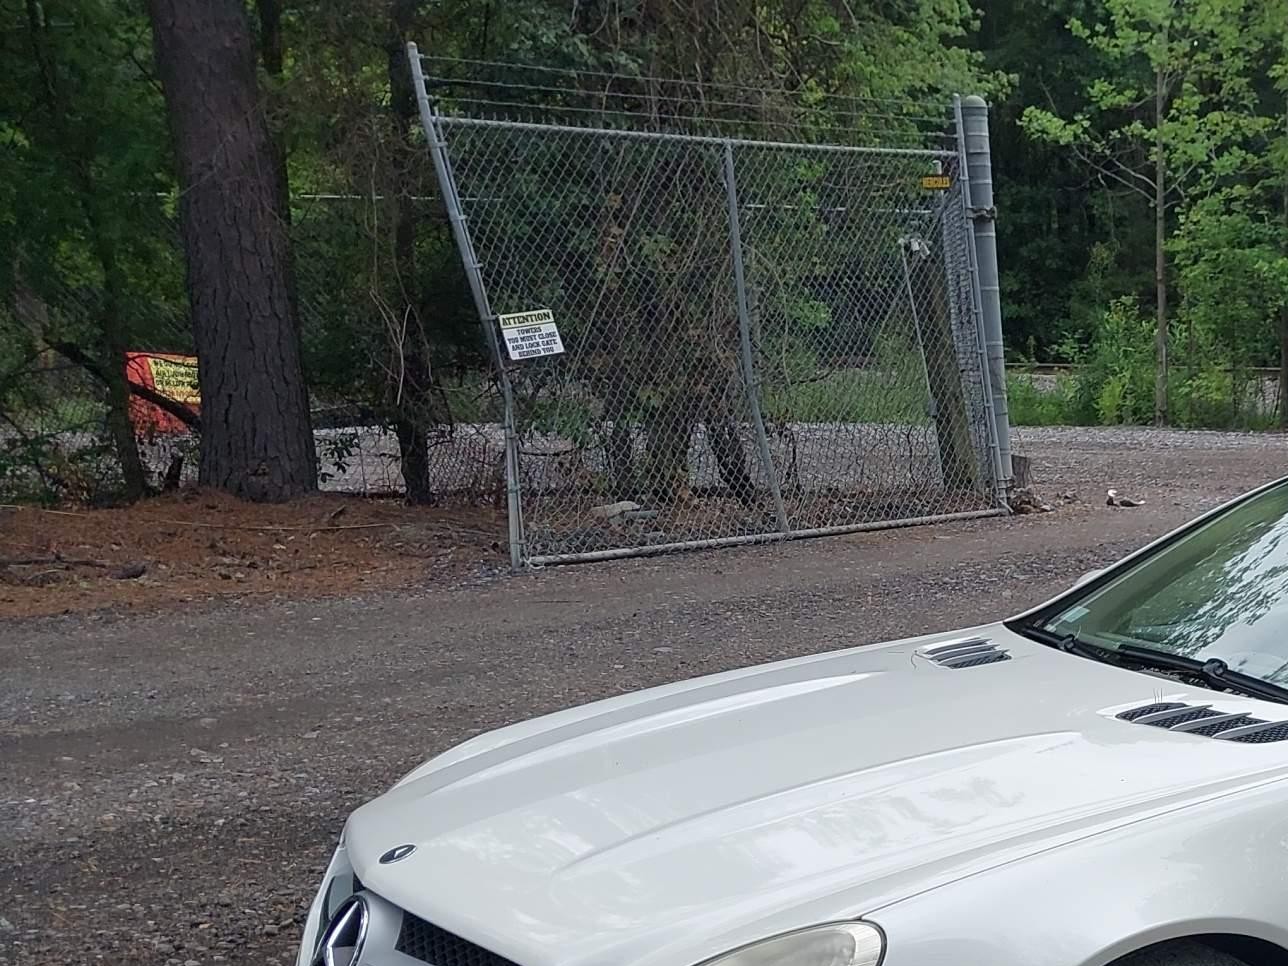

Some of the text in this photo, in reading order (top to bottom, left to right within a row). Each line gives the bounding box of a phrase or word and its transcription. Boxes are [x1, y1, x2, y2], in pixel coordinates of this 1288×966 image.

[502, 312, 551, 326] ATTENTION
[517, 327, 542, 335] TOWERS
[538, 332, 557, 340] CLOSE
[525, 340, 541, 349] LOCK
[518, 349, 541, 357] BEHIND
